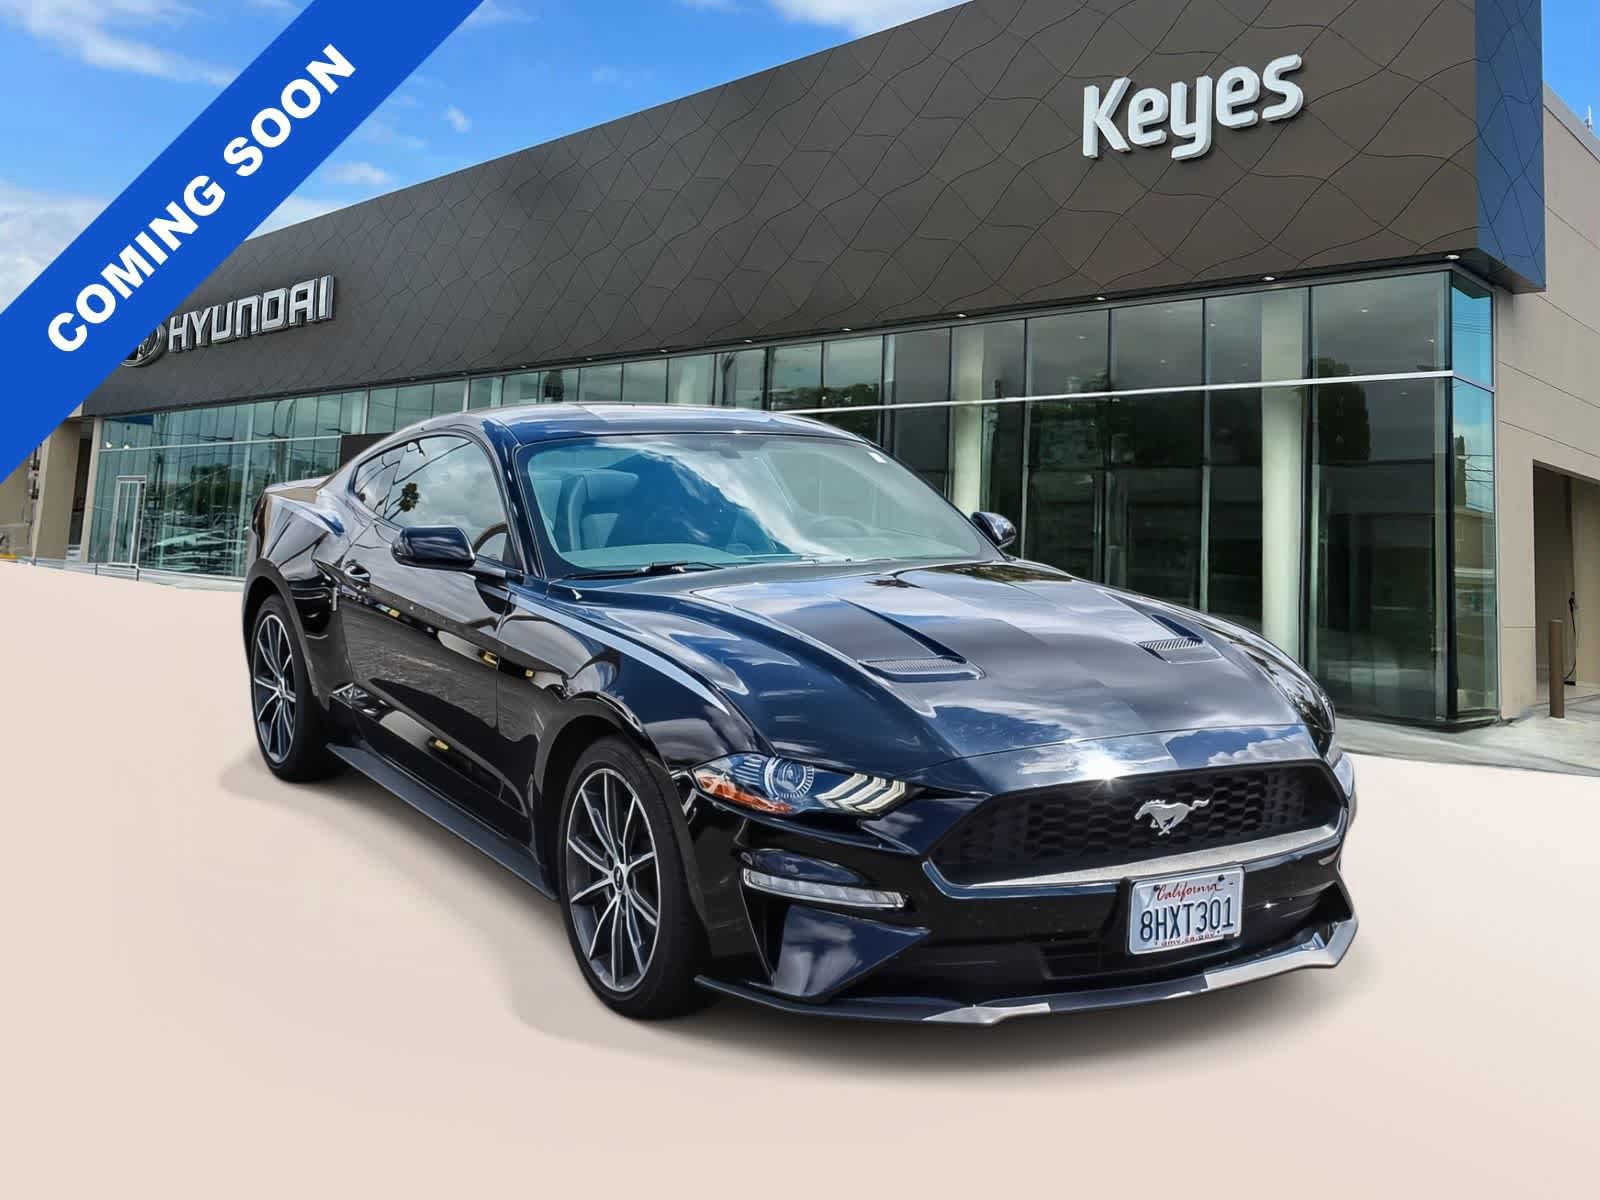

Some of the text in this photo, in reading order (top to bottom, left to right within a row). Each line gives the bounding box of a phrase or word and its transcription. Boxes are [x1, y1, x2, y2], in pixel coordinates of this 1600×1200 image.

[1082, 53, 1304, 161] Keyes
[168, 274, 335, 352] HYUNDAI
[1140, 896, 1234, 942] 8HXT301
[1158, 881, 1223, 902] California
